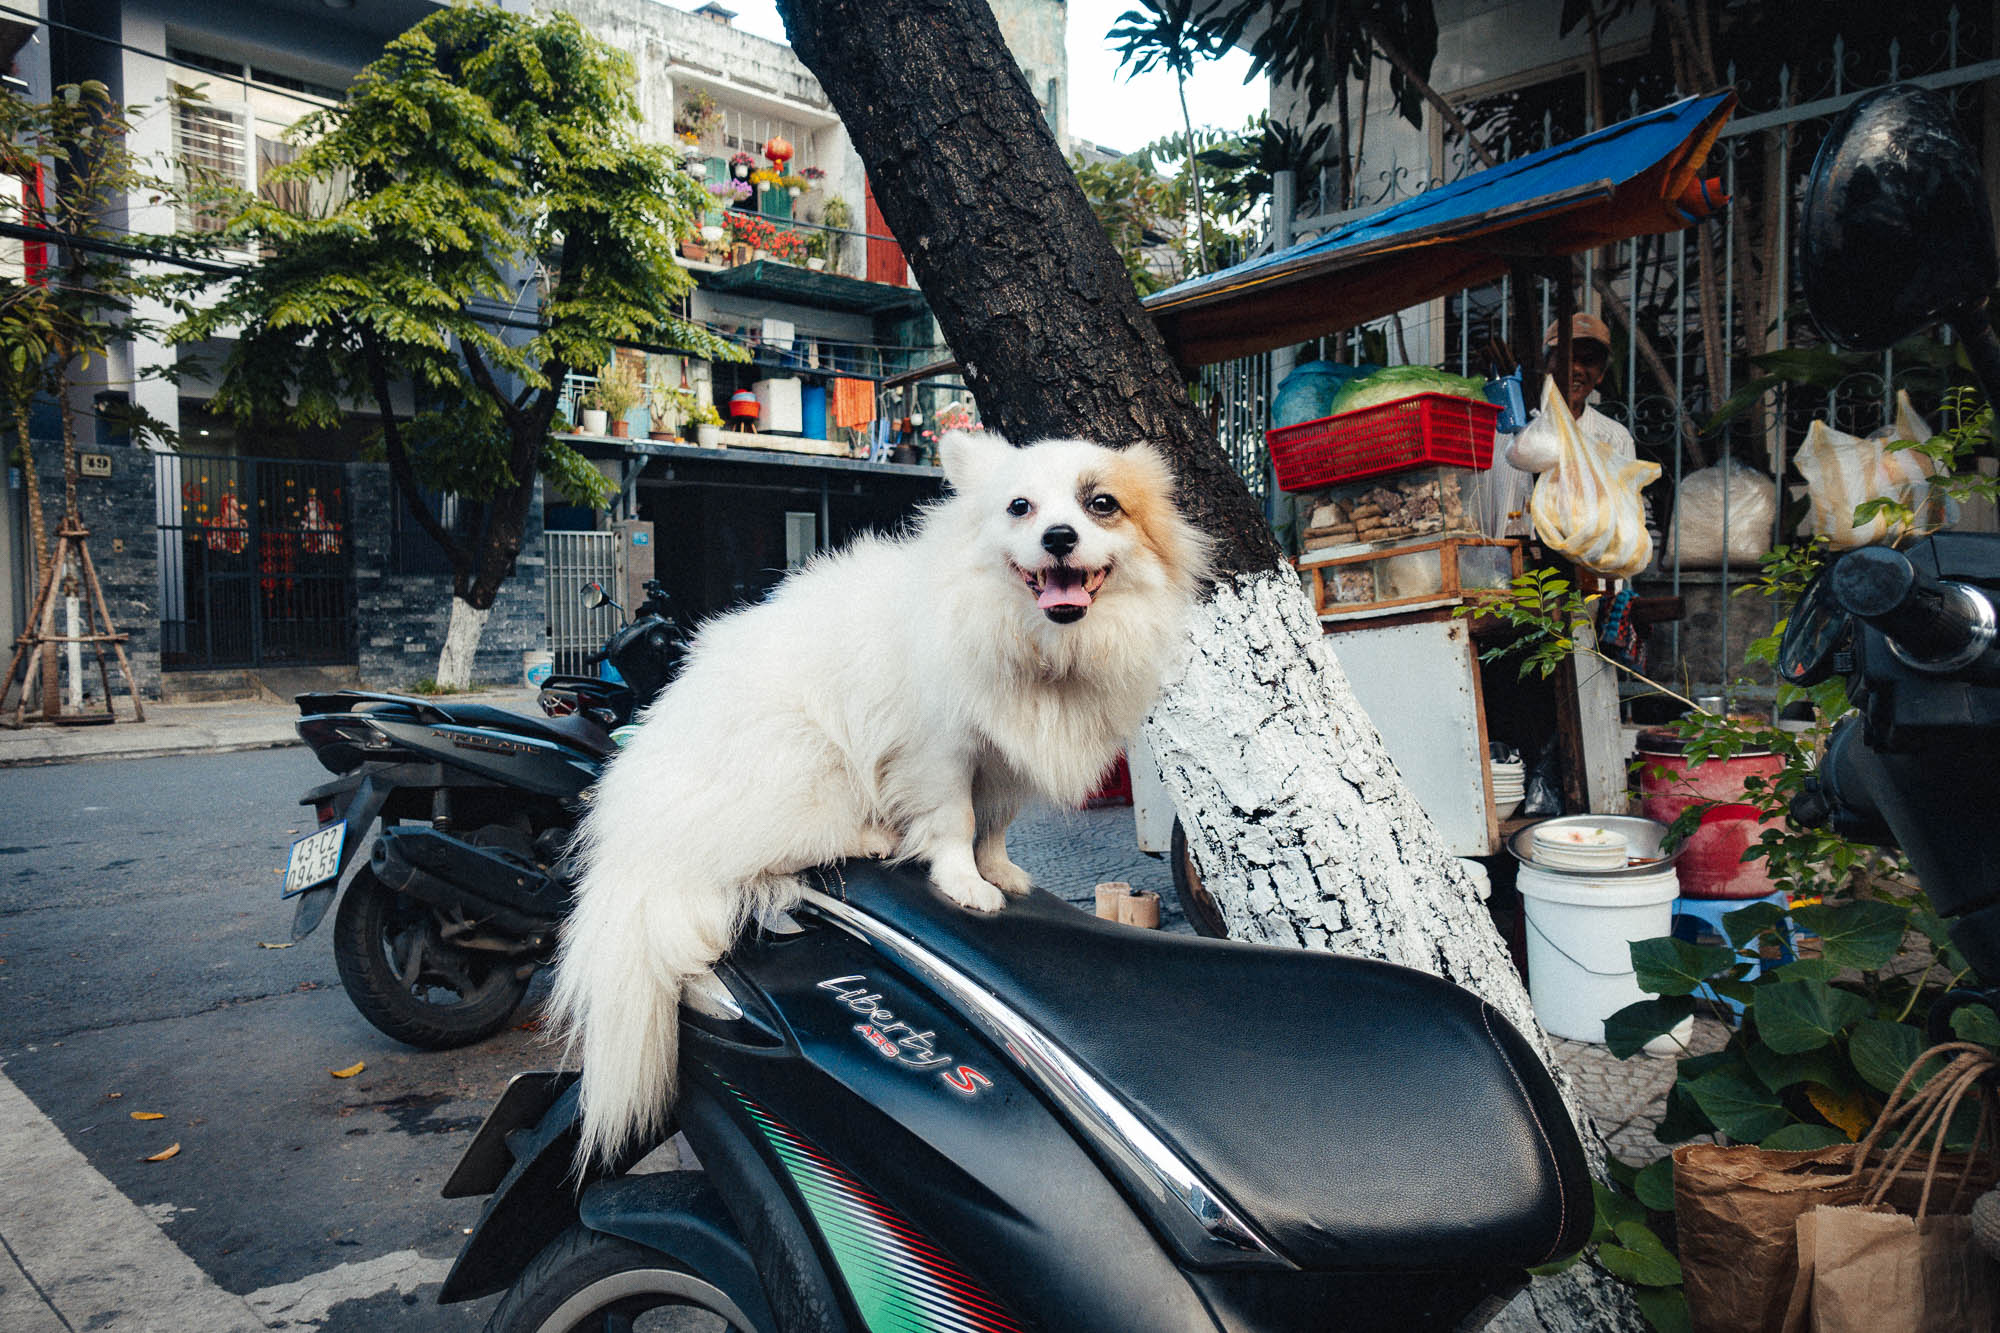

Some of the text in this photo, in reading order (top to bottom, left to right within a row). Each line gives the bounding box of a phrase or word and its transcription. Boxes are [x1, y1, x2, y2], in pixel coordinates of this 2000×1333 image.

[297, 828, 337, 863] 43-C2
[286, 850, 338, 892] 094.55
[817, 975, 994, 1096] Liberty S
[854, 1024, 900, 1058] ABS
